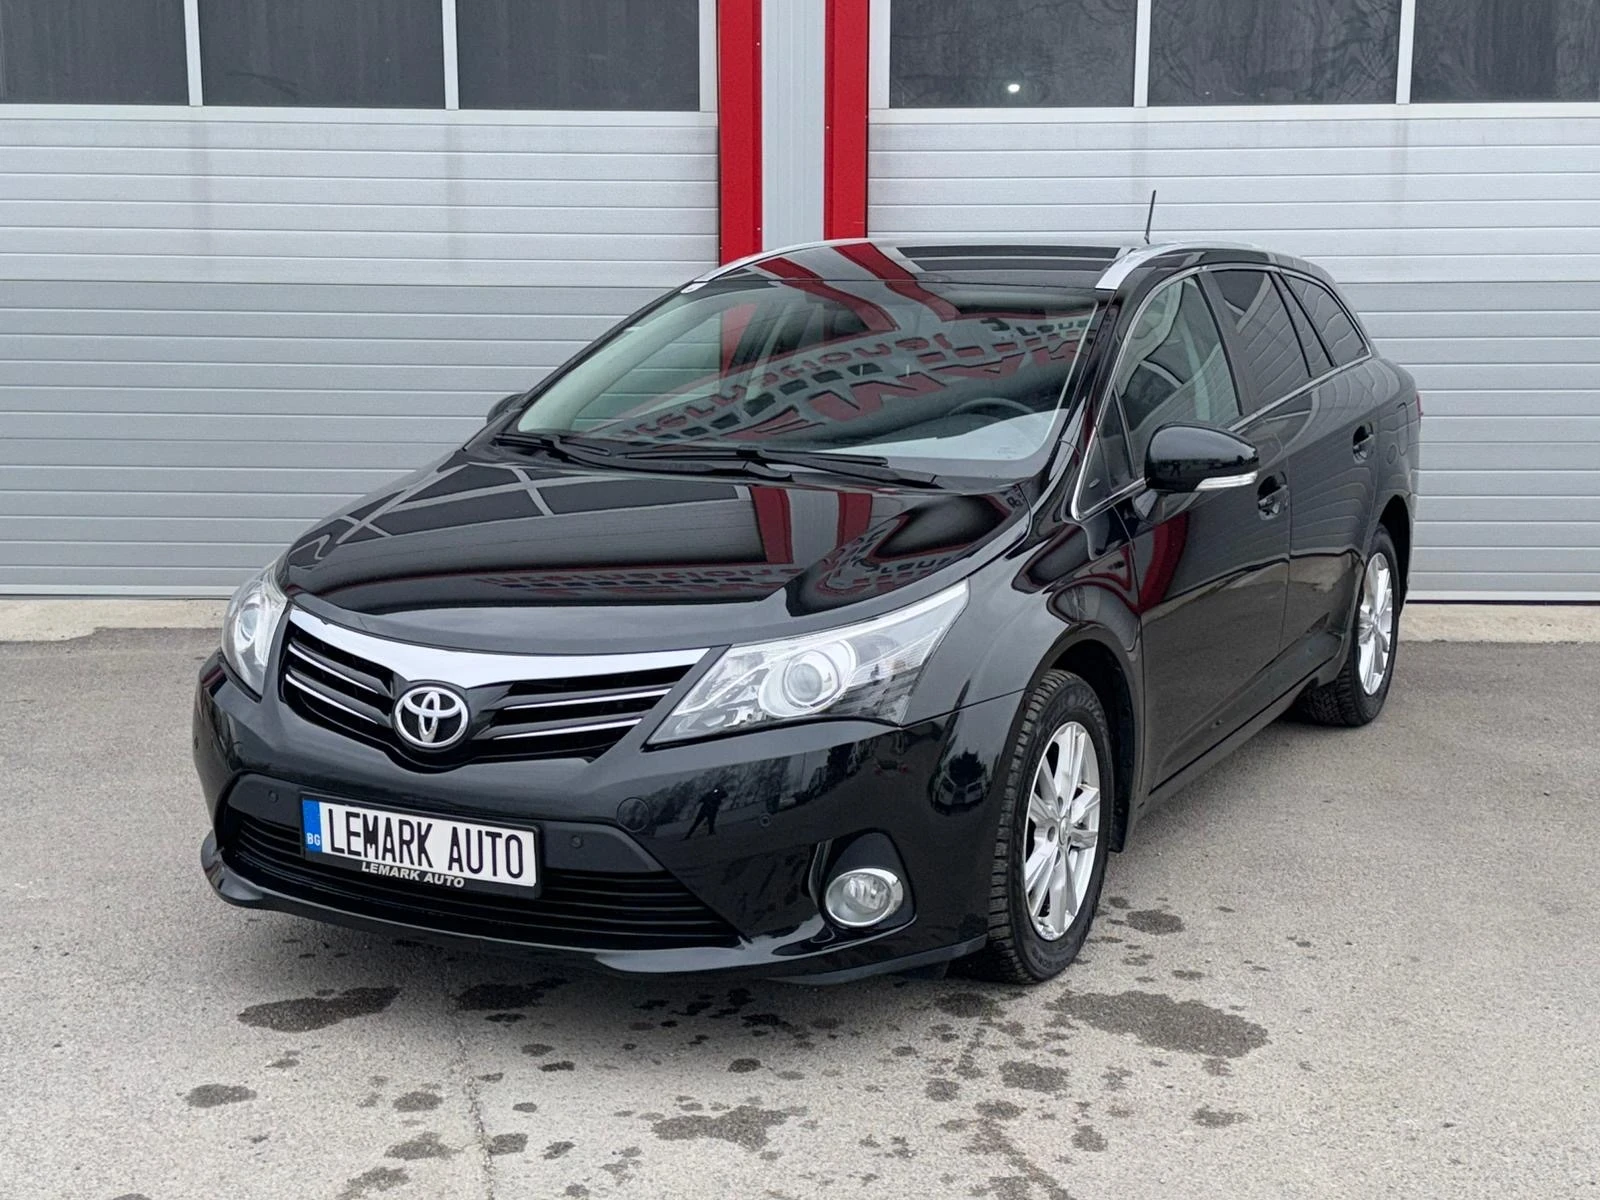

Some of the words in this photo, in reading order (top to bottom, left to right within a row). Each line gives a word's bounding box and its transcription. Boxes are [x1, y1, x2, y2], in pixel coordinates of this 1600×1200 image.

[306, 832, 321, 846] BG
[328, 808, 433, 868] LEMARK
[448, 826, 524, 879] AUTO
[361, 861, 420, 881] LEMARK
[423, 872, 465, 889] AUTO
